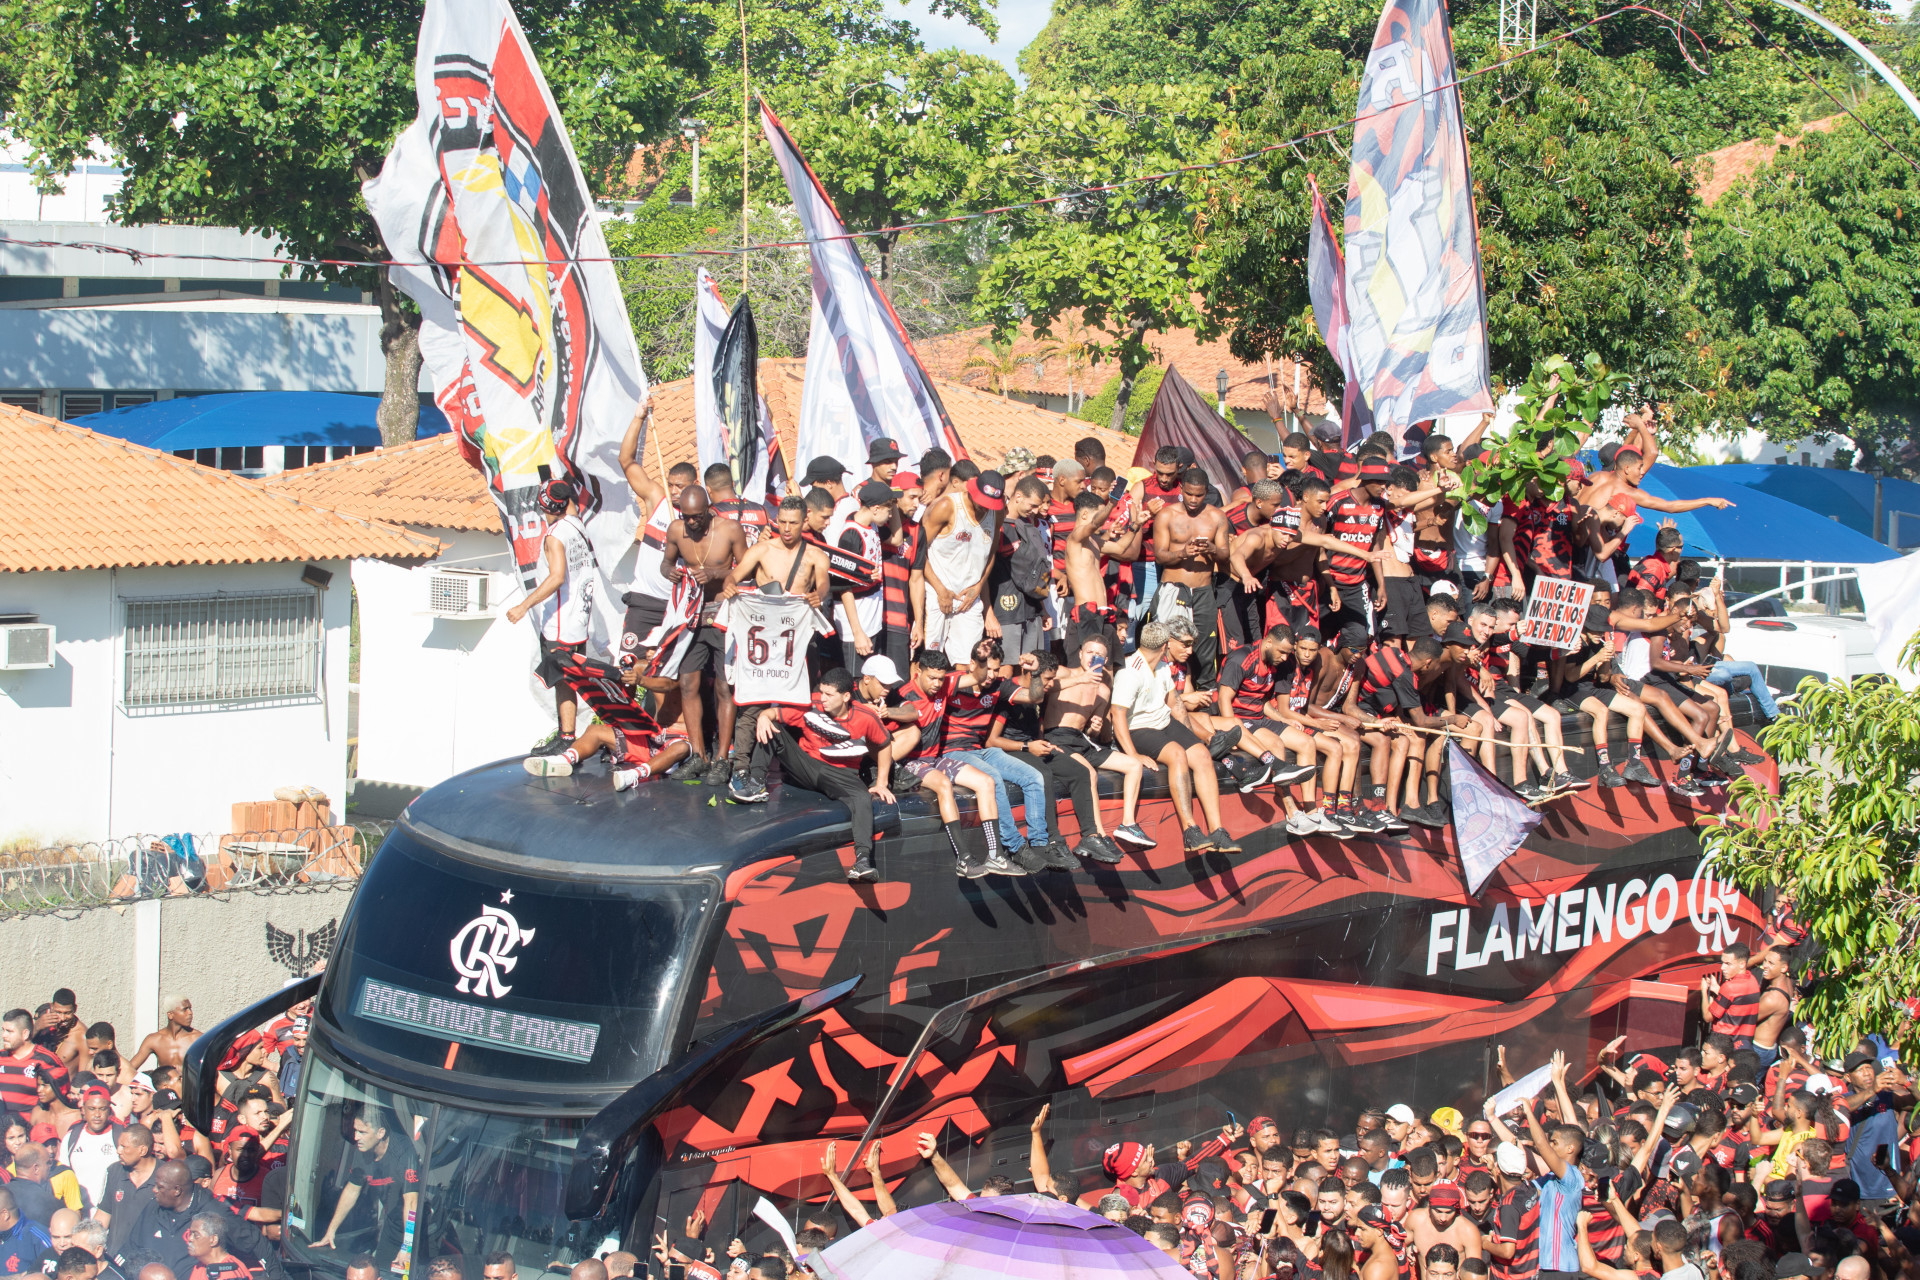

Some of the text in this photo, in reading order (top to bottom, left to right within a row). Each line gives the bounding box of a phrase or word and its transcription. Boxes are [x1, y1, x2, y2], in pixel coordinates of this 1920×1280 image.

[1340, 532, 1373, 544] pixbet
[1537, 581, 1586, 605] NINGUÉM
[750, 613, 795, 626] FLA VAS
[1529, 600, 1584, 625] MORRE NOS
[1525, 619, 1578, 647] DEVENDO!
[747, 625, 769, 665] 6
[780, 629, 795, 667] 1
[752, 668, 789, 679] FOI POUCO
[1427, 873, 1679, 976] FLAMENGO
[427, 997, 485, 1035] AMOR
[489, 1011, 506, 1040] E
[689, 1145, 736, 1160] Marcopolo
